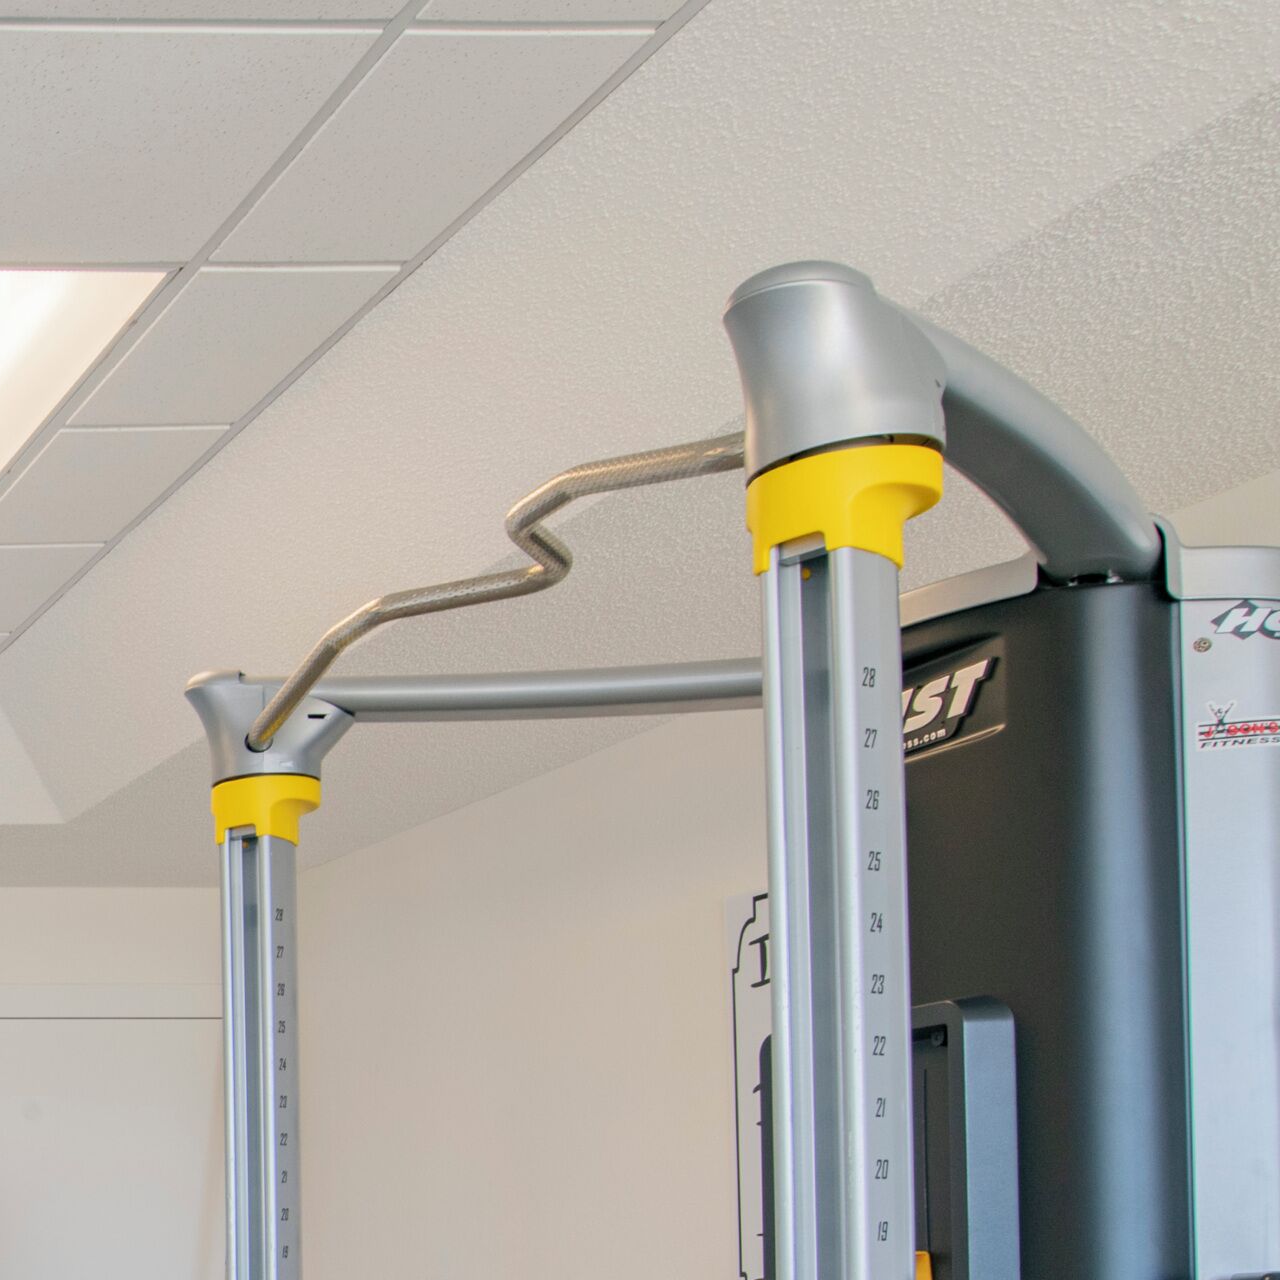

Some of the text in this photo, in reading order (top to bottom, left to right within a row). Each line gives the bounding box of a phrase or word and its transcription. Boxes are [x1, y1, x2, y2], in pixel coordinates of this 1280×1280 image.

[861, 666, 876, 688] 28
[863, 727, 878, 749] 27
[865, 789, 880, 811] 26
[867, 850, 882, 872] 25
[869, 912, 883, 933] 24
[276, 945, 285, 959] 27
[870, 973, 885, 995] 23
[277, 1020, 286, 1034] 25
[872, 1035, 887, 1057] 22
[278, 1057, 287, 1071] 24
[279, 1095, 288, 1109] 23
[875, 1097, 886, 1118] 21
[279, 1132, 289, 1147] 22
[280, 1170, 288, 1184] 21
[874, 1158, 889, 1180] 20
[877, 1220, 889, 1242] 19
